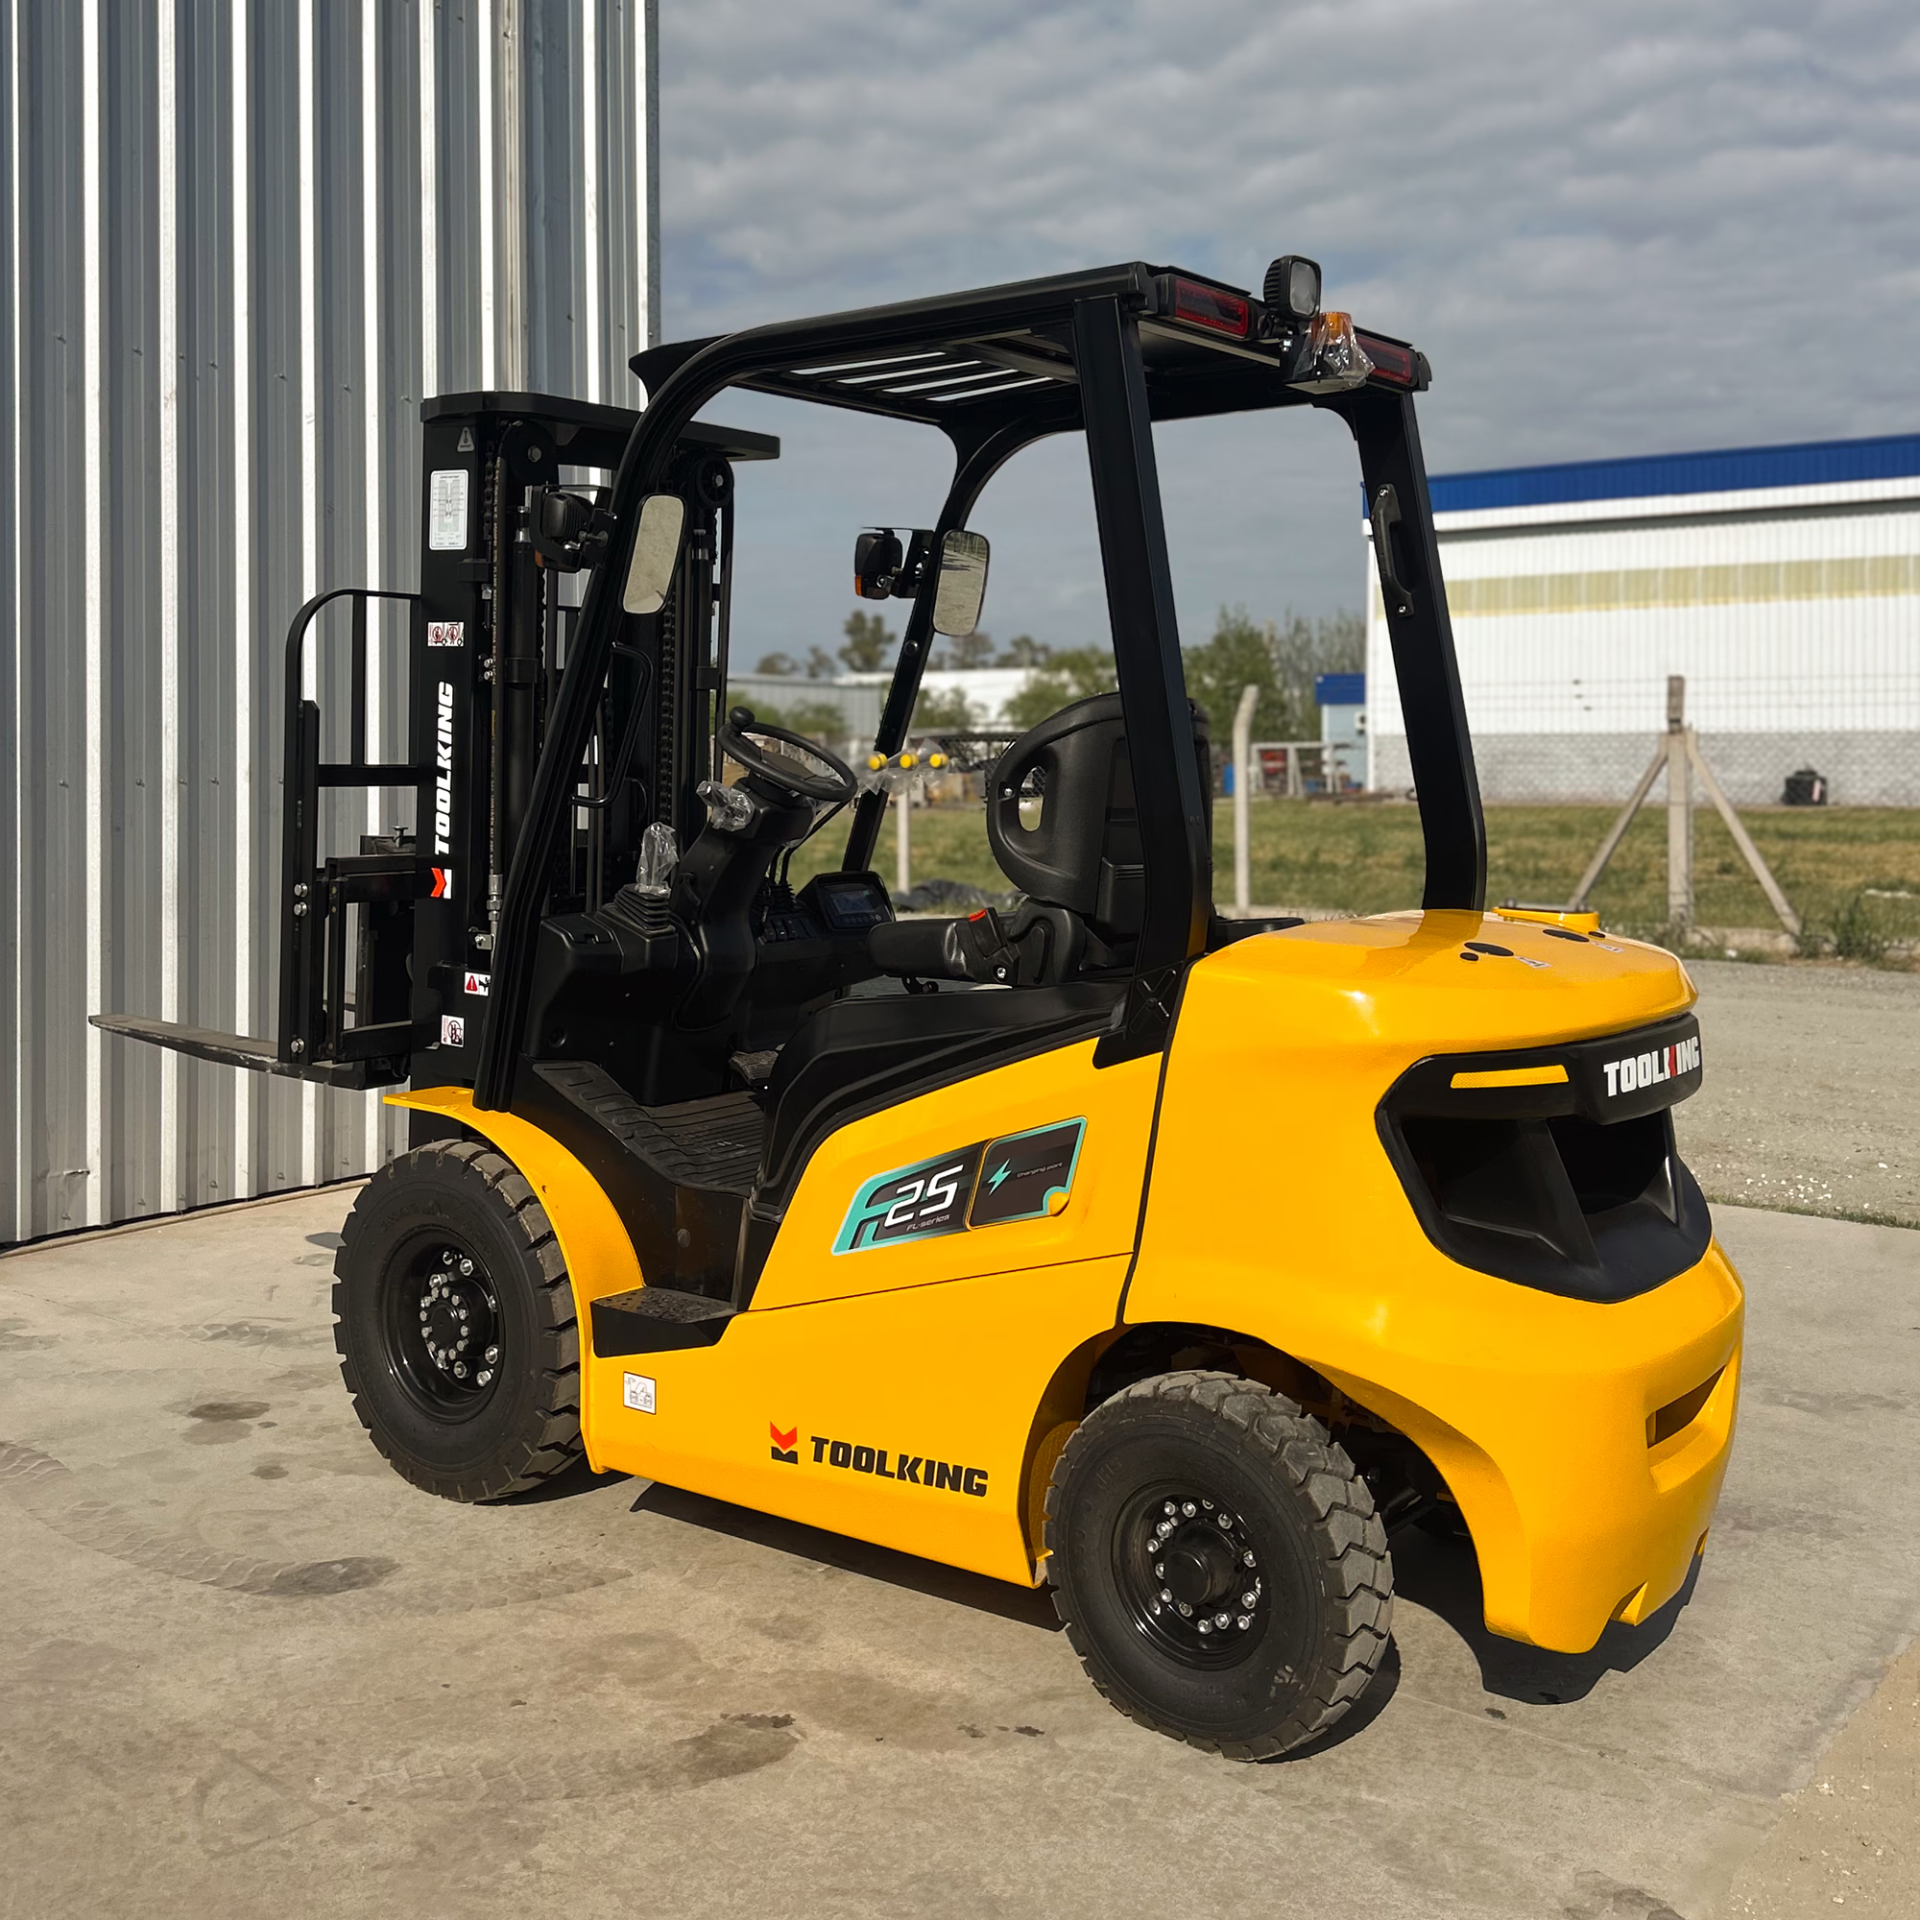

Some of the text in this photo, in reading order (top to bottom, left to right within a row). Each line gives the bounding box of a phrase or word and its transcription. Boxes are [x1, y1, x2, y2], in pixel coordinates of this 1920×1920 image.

[434, 681, 454, 856] TOOLKING
[1603, 1036, 1700, 1097] TOOLKING
[906, 1214, 950, 1232] FL-series
[810, 1435, 989, 1497] TOOLKING
